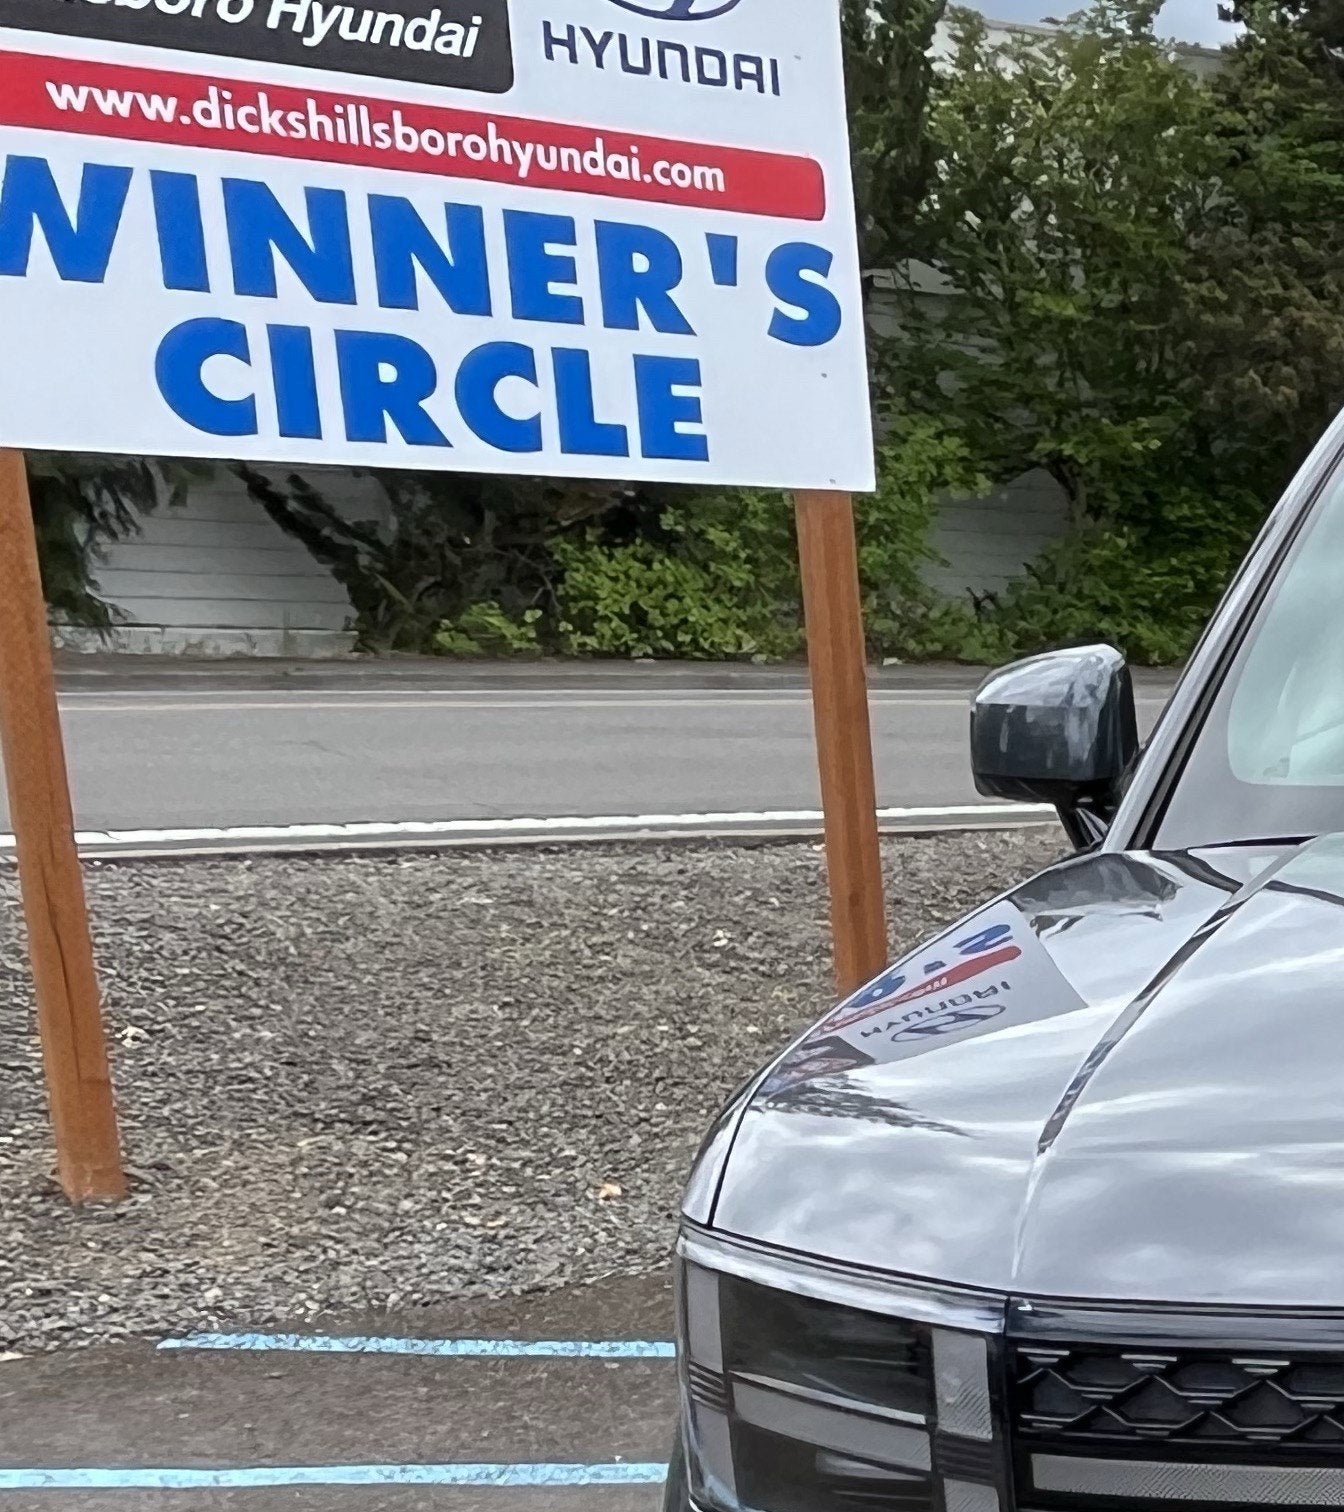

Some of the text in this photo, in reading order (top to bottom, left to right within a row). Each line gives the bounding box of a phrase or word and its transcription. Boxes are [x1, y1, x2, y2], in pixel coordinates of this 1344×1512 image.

[266, 0, 483, 57] Hyundai
[543, 20, 782, 97] HYUNDAI
[45, 79, 726, 193] www.dickshillsborohyundai.com
[0, 154, 842, 348] WINNER'S
[154, 316, 710, 463] CIRCLE
